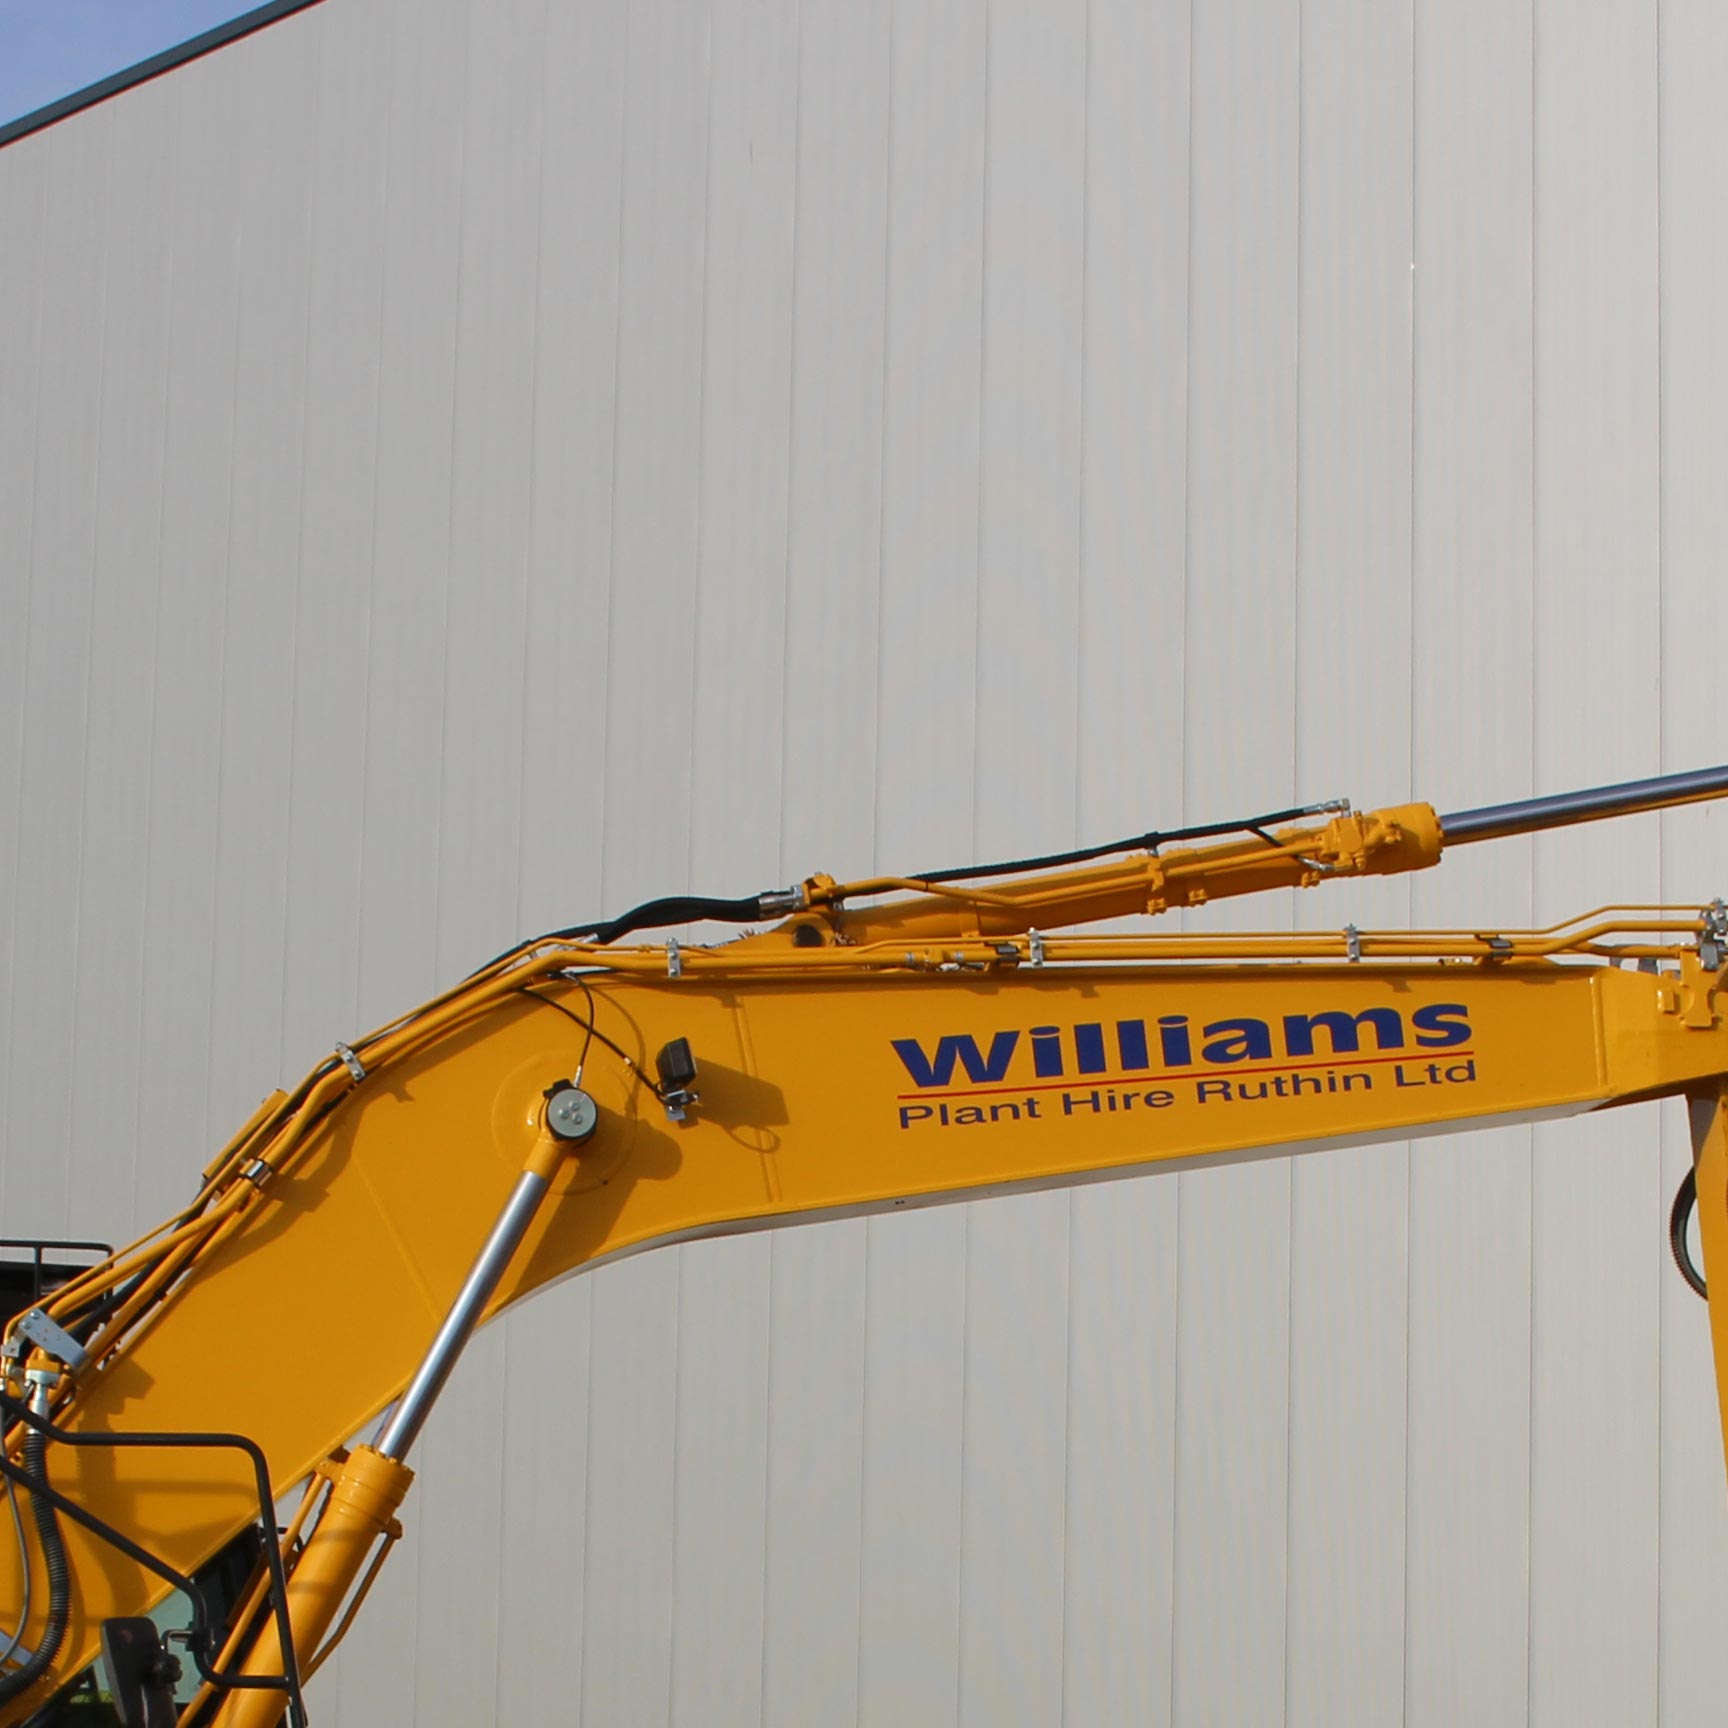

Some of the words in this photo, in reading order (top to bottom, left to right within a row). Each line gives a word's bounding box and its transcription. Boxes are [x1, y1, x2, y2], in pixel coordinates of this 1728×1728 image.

[890, 1002, 1473, 1088] Williams
[899, 1099, 1041, 1129] Plant
[1063, 1089, 1175, 1115] Hire
[1197, 1068, 1373, 1104] Ruthin
[1395, 1060, 1477, 1087] Ltd
